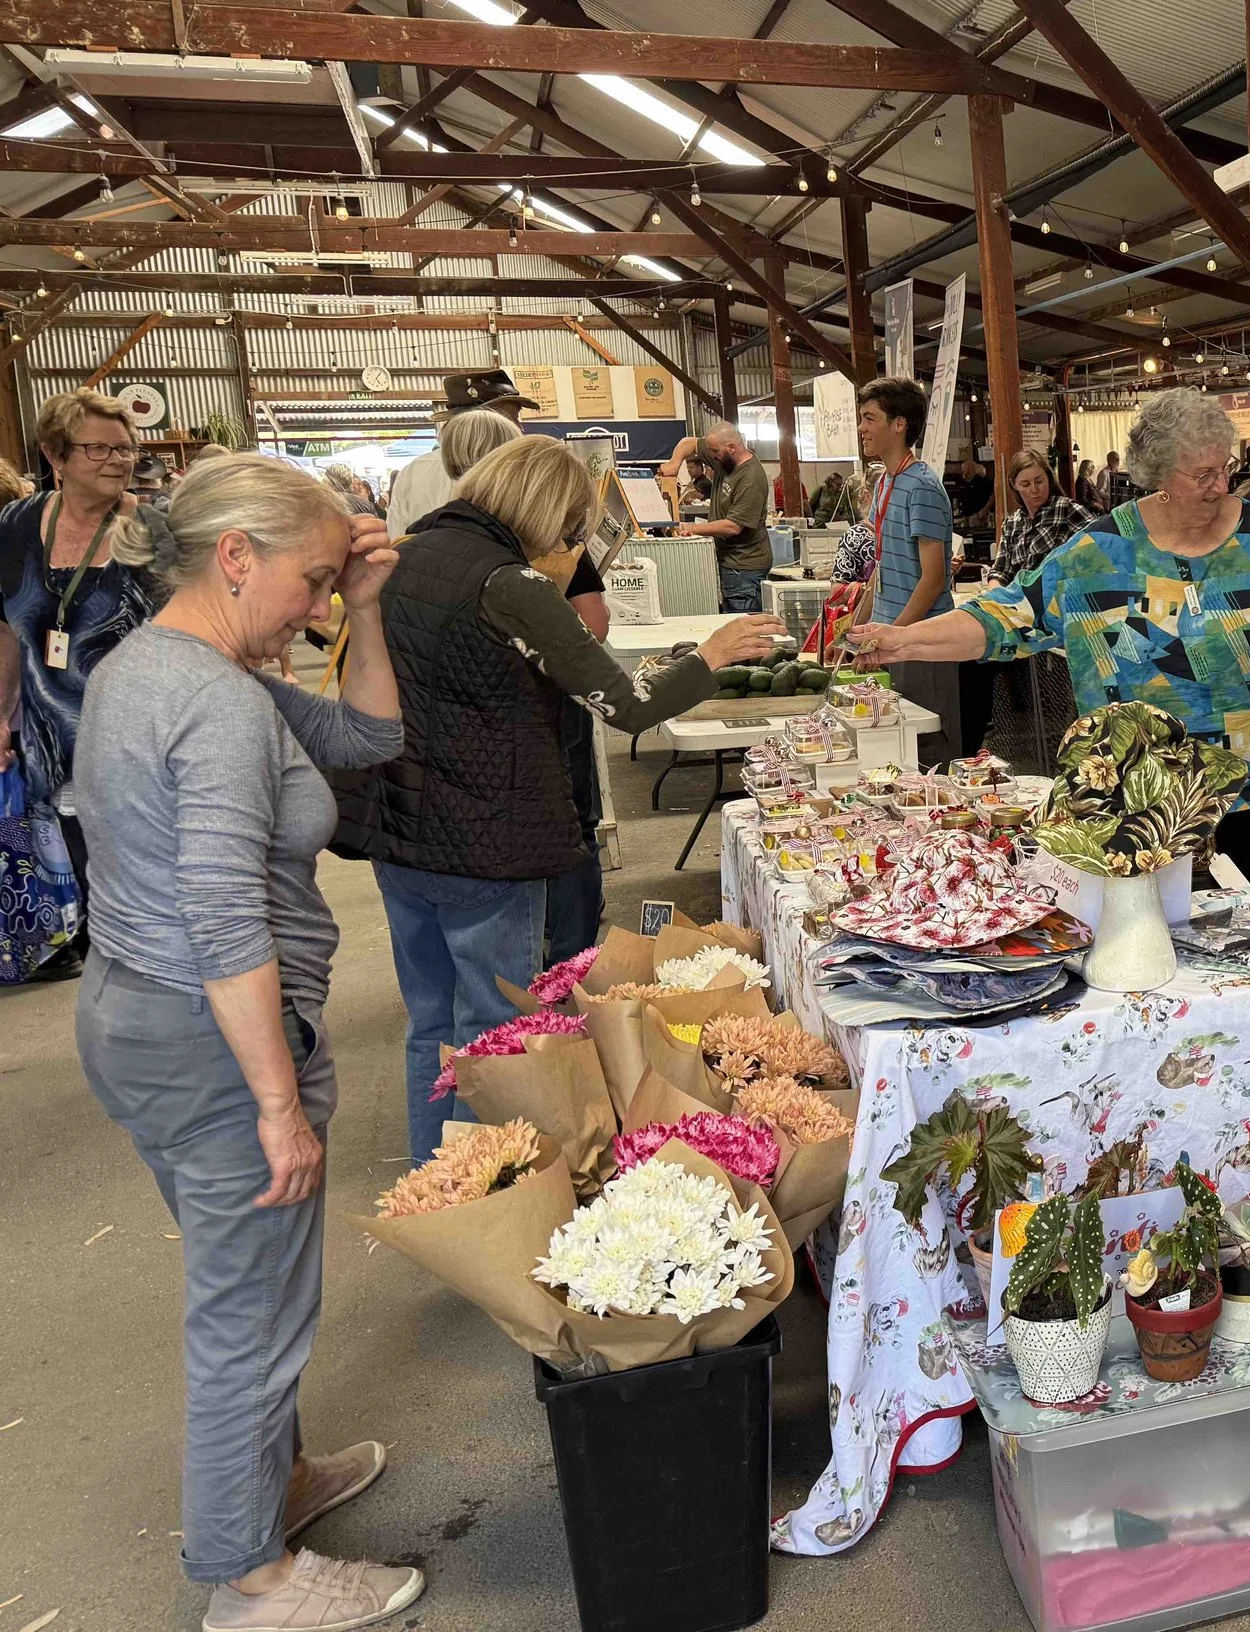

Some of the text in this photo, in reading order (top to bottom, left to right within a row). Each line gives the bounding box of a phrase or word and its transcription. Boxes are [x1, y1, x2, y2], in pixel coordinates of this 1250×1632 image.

[307, 443, 330, 452] ATM
[611, 577, 645, 587] HOME
[1050, 864, 1080, 896] $20 each
[644, 904, 670, 935] $20
